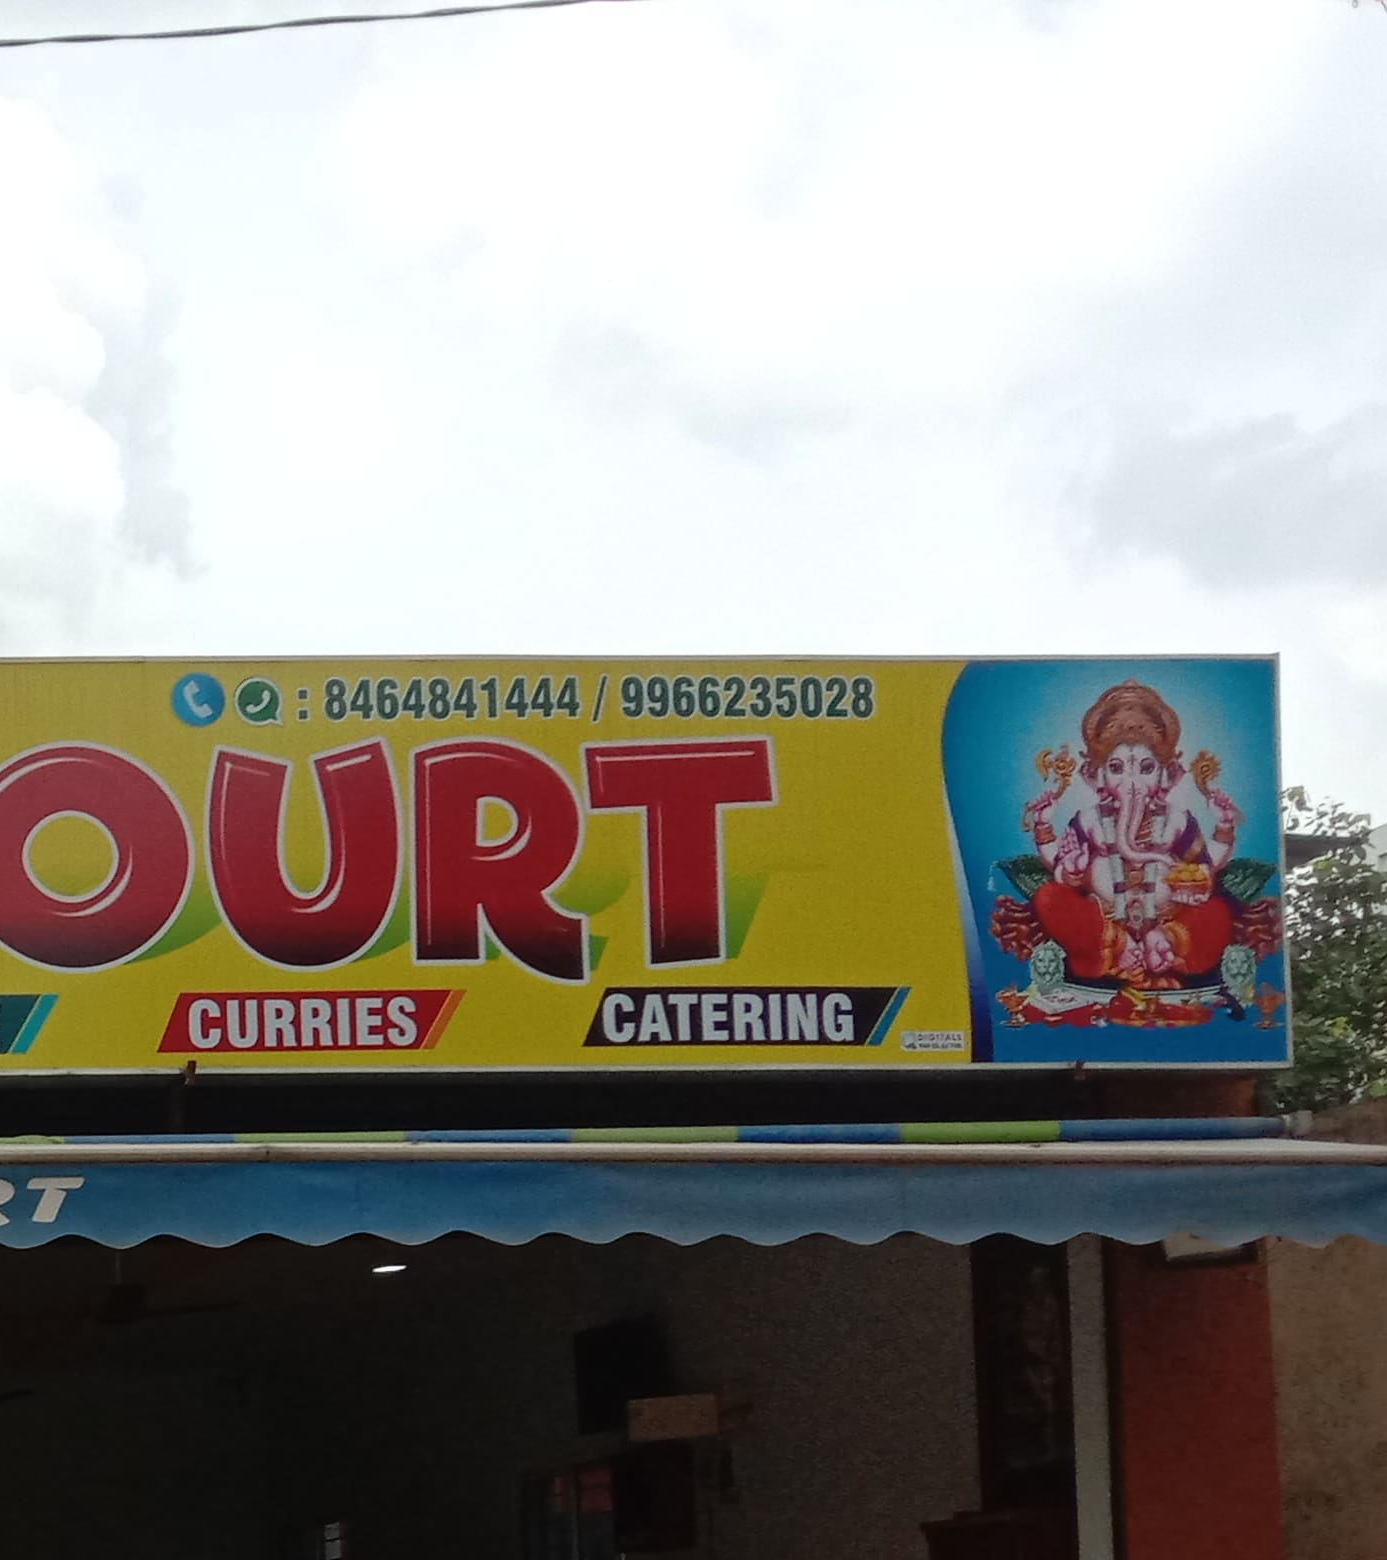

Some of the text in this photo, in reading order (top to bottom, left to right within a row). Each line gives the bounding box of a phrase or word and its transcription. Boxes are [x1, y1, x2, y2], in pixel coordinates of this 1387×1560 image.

[323, 677, 580, 722] 8464841444
[620, 677, 874, 719] 9966235028
[186, 997, 417, 1050] CURRIES
[603, 992, 856, 1045] CATERING
